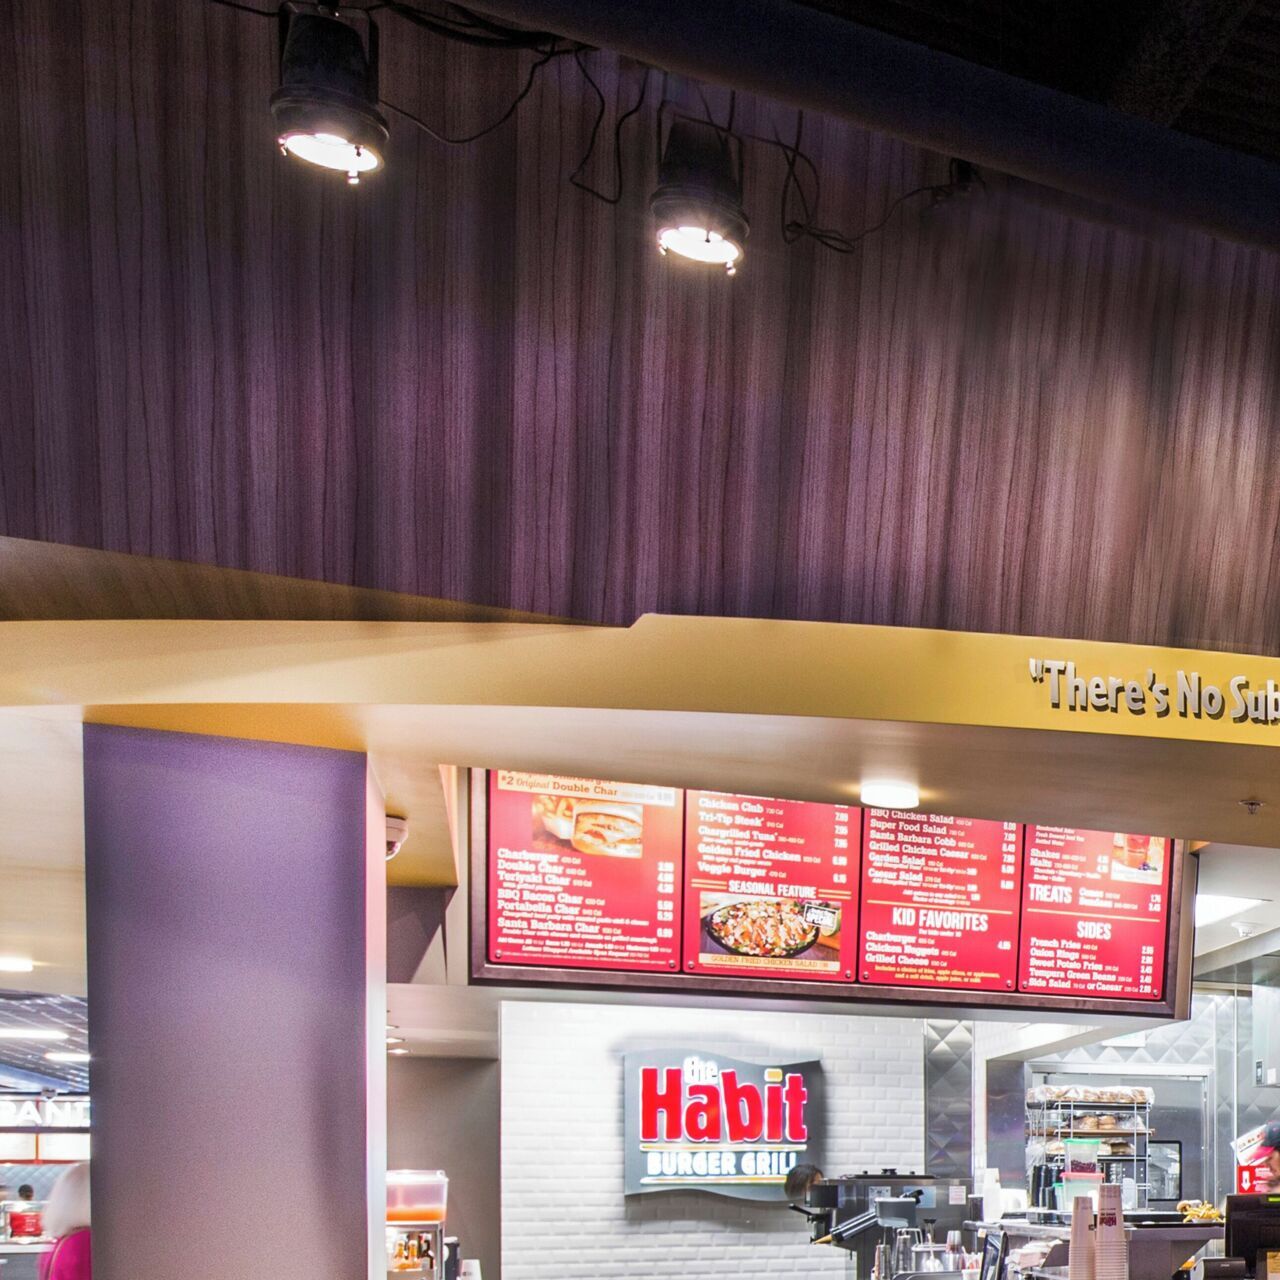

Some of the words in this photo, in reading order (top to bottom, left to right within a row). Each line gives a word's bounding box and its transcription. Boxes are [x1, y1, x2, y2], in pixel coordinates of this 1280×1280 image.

[1177, 669, 1222, 718] No
[501, 775, 514, 785] #2
[516, 778, 549, 790] Original
[552, 781, 589, 794] Double
[594, 786, 618, 796] Char
[699, 798, 739, 812] Chicken
[741, 802, 763, 813] Club
[871, 808, 889, 818] BBQ
[892, 810, 927, 822] Chicken
[930, 814, 953, 824] Salad
[870, 819, 896, 830] Super
[899, 822, 920, 832] Food
[923, 825, 947, 835] Salad
[870, 830, 895, 840] Santa
[898, 833, 932, 844] Barbara
[934, 836, 956, 847] Cobb
[869, 841, 899, 852] Grilled
[902, 844, 937, 855] Chicken
[940, 848, 969, 859] Caesar
[1030, 848, 1060, 859] Shakes
[869, 852, 899, 862] Garden
[902, 856, 925, 866] Salad
[868, 868, 897, 879] Caesar
[899, 871, 923, 881] Salad
[729, 880, 775, 896] SEASONAL
[778, 884, 816, 898] FEATURE
[1029, 883, 1072, 904] TREATS
[498, 918, 528, 929] Santa
[530, 920, 572, 931] Barbara
[575, 923, 599, 933] Char
[893, 907, 915, 926] KID
[919, 909, 988, 931] FAVORITES
[1077, 921, 1111, 940] SIDES
[866, 942, 902, 953] Chicken
[904, 945, 939, 956] Nuggets
[1030, 937, 1059, 948] French
[1061, 940, 1081, 949] Fries
[711, 955, 738, 963] GOLDEN
[764, 959, 793, 967] CHICKEN
[865, 953, 896, 964] Grilled
[898, 955, 929, 966] Cheese
[1030, 958, 1054, 968] Sweet
[1056, 961, 1081, 969] Potato
[1083, 961, 1103, 971] Fries
[683, 1056, 719, 1084] the
[639, 1066, 808, 1143] Habit
[647, 1152, 736, 1175] BURGER
